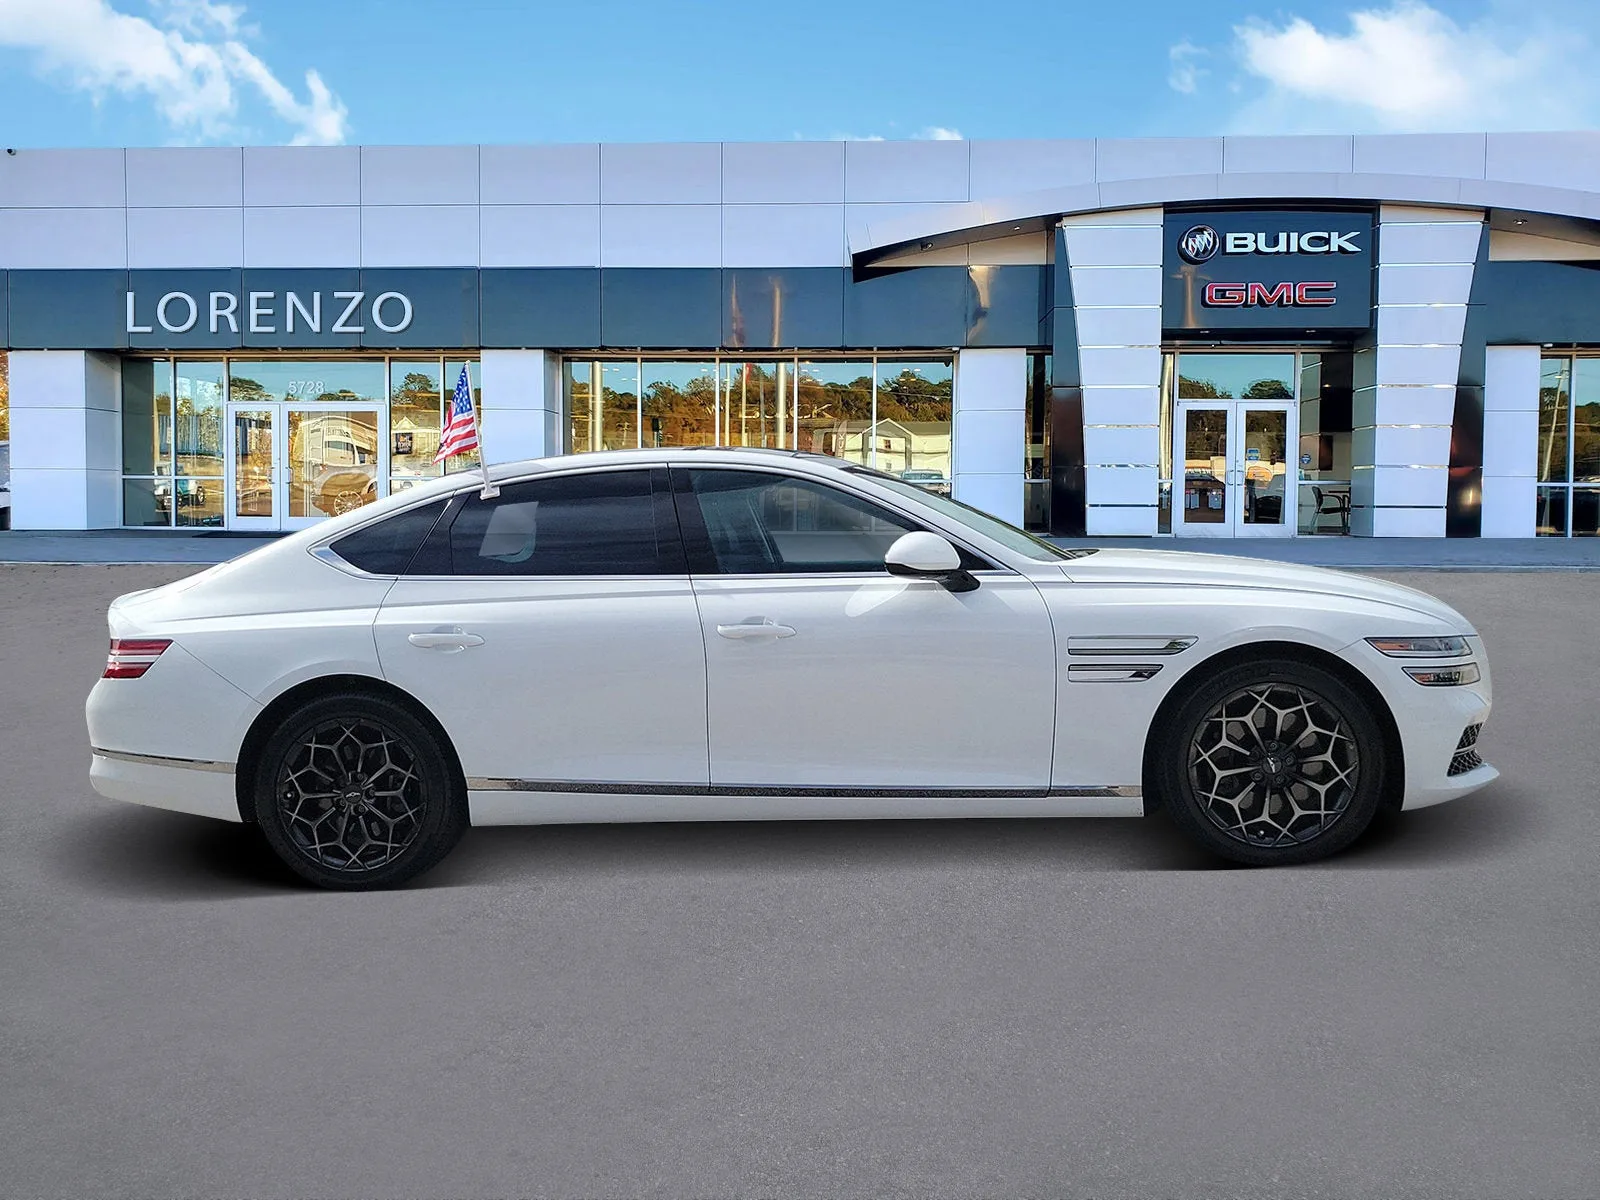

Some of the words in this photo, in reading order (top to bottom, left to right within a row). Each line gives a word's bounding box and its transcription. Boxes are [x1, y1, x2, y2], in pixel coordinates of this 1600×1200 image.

[1225, 231, 1362, 253] BUICK
[1205, 282, 1337, 305] GMC
[126, 291, 414, 333] LORENZO
[288, 380, 325, 394] 5728
[738, 403, 834, 418] BUCK
